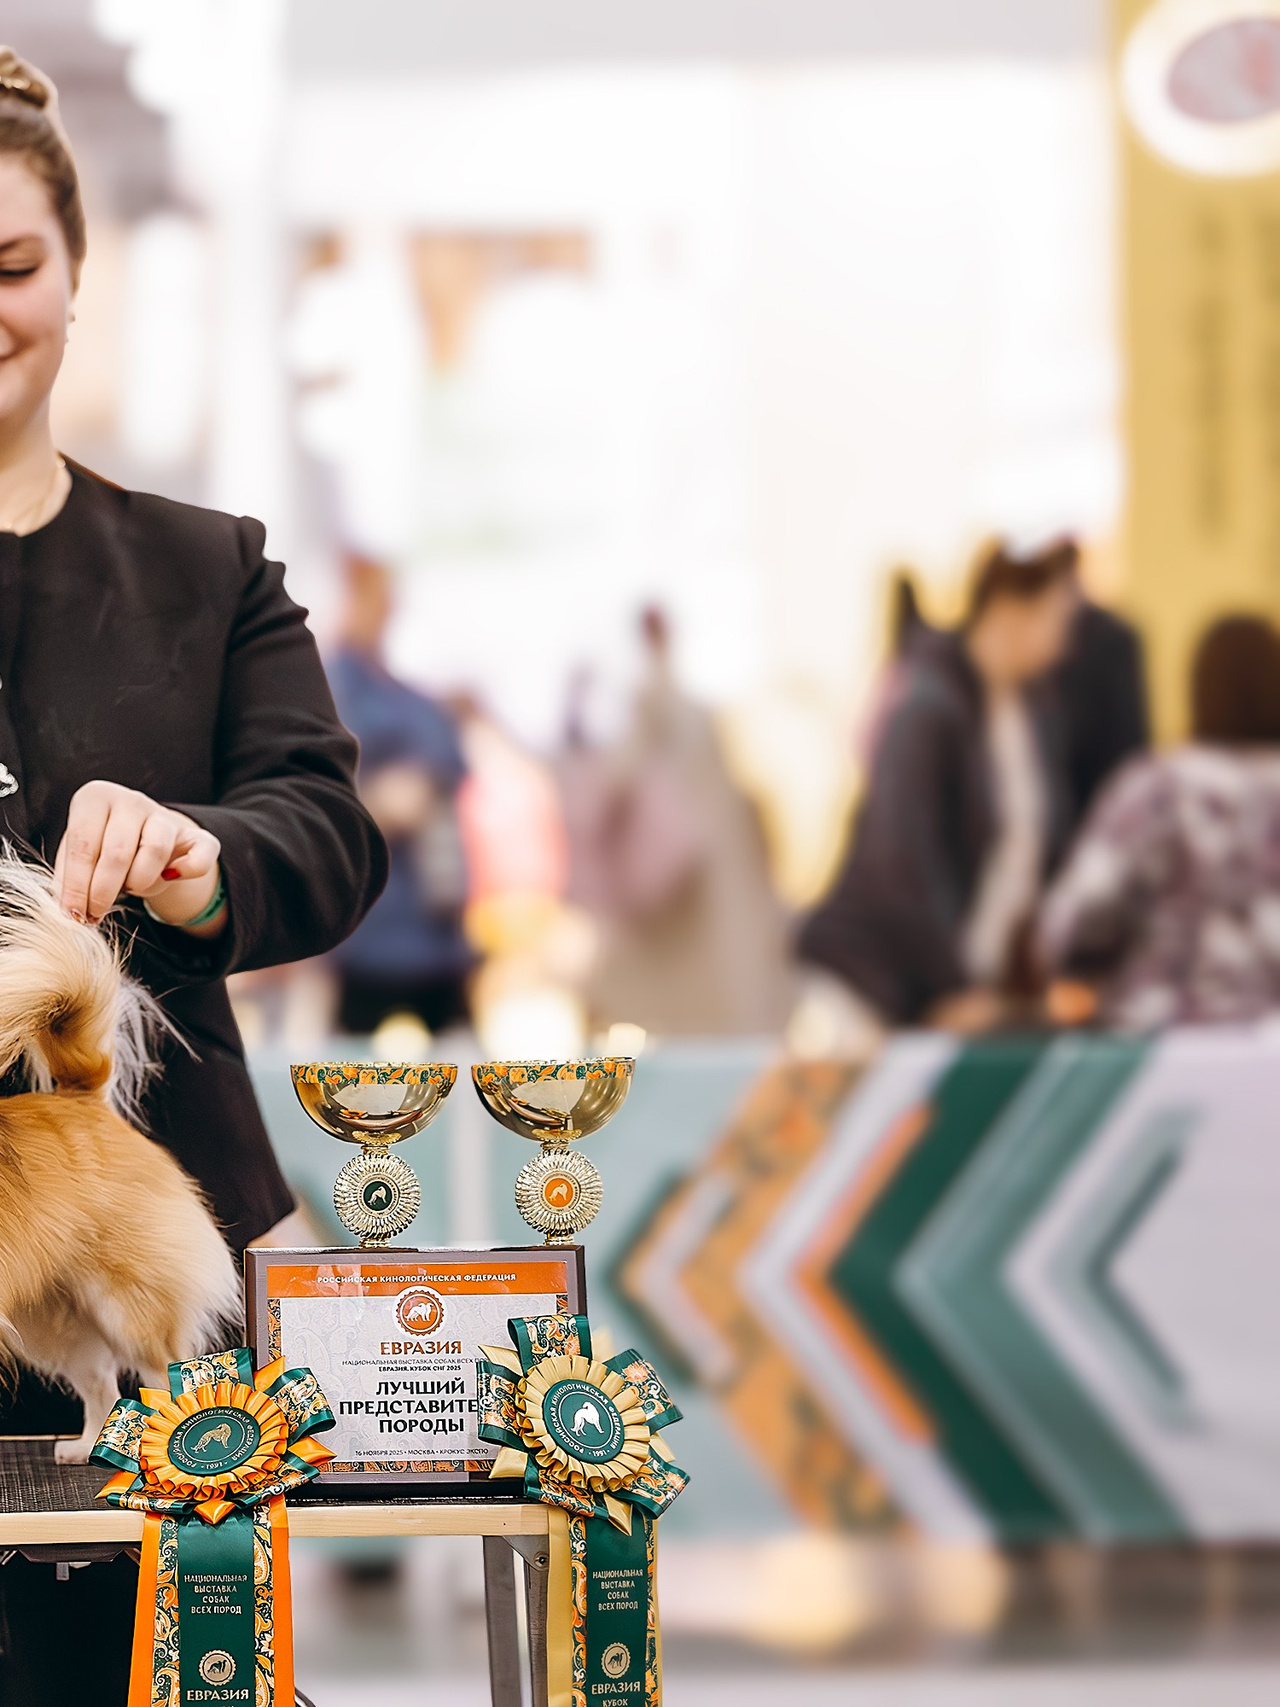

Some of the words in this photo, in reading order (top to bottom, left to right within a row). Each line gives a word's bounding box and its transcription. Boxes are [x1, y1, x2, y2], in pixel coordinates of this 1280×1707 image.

[317, 1275, 378, 1284] РОССИЙСКАЯ
[380, 1273, 462, 1283] КИНОЛОГИЧЕСКАЯ
[463, 1273, 516, 1283] ФЕДЕРАЦИЯ
[380, 1341, 462, 1356] ЕВРАЗИЯ
[376, 1377, 465, 1395] ЛУЧШИЙ
[551, 1383, 609, 1406] КИНОЛОГИЧЕСКАЯ
[339, 1400, 477, 1417] ПРЕДСТАВИТЕ
[379, 1418, 464, 1435] ПОРОДЫ
[550, 1406, 585, 1454] РОССИЙСКАЯ
[183, 1574, 248, 1583] НАЦИОНАЛЬНАЯ
[592, 1568, 644, 1579] НАЦИОНАЛЬНАЯ
[194, 1585, 238, 1594] ВЫСТАВКА
[600, 1580, 636, 1590] ВЫСТАВКА
[202, 1595, 230, 1604] СОБАК
[607, 1591, 630, 1600] СОБАК
[191, 1606, 212, 1614] ВСЕХ
[213, 1605, 242, 1615] ПОРОД
[598, 1602, 615, 1611] ВСЕХ
[615, 1601, 639, 1610] ПОРОД
[591, 1681, 641, 1695] ЕВРАЗИЯ
[186, 1689, 249, 1701] ЕВРАЗИЯ
[602, 1698, 628, 1707] КУБОК
